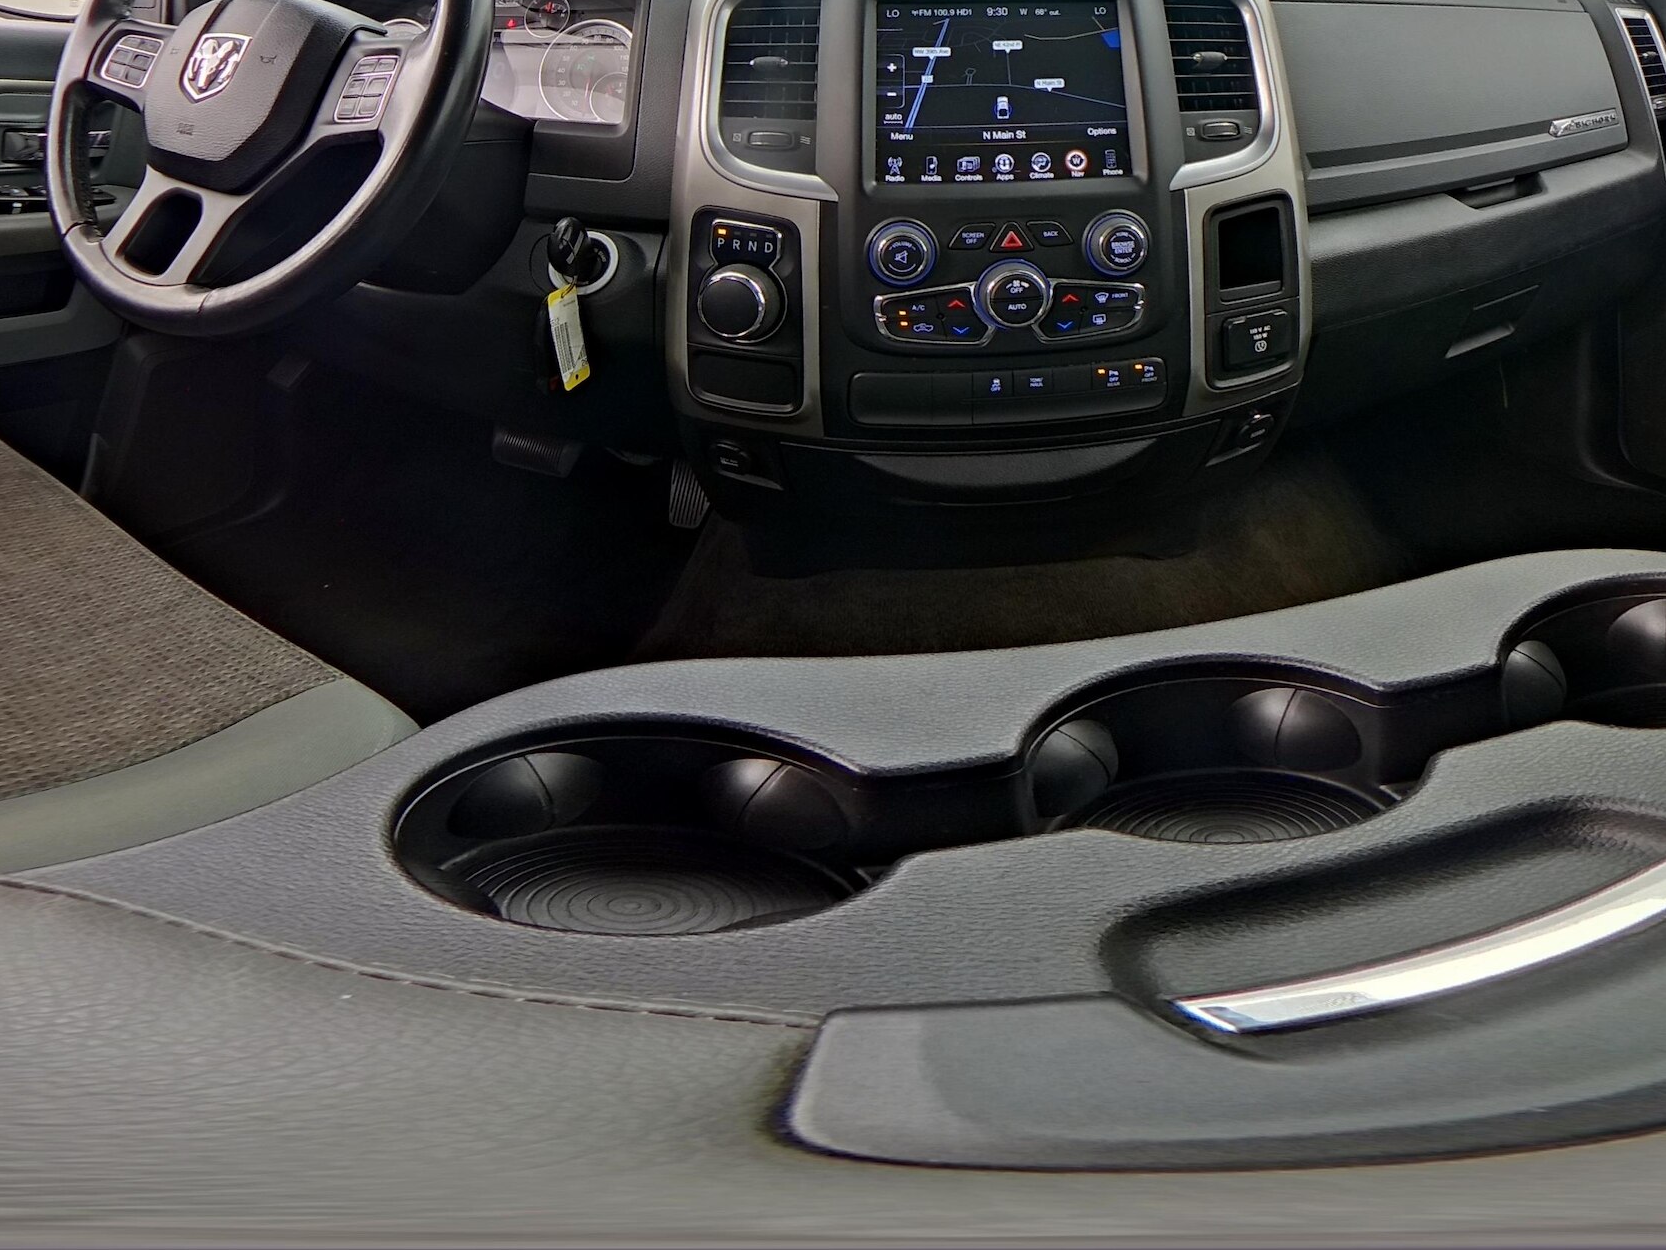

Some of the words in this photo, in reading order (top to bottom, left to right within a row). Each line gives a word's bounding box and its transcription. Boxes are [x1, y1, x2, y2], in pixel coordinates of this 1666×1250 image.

[886, 9, 900, 18] LO
[956, 8, 973, 16] HD1
[986, 7, 1008, 16] 9:30
[1094, 6, 1107, 15] LO
[890, 132, 914, 141] Menu
[982, 131, 991, 140] N
[992, 130, 1014, 140] Main
[1015, 130, 1026, 139] St
[1087, 127, 1117, 137] Options
[885, 174, 905, 182] Radio
[921, 174, 942, 182] Media
[954, 174, 983, 182] Controls
[996, 173, 1014, 181] Apps
[1102, 168, 1124, 176] Phone
[717, 237, 725, 248] P
[732, 239, 741, 251] R
[747, 240, 757, 252] N
[764, 241, 774, 253] D
[892, 240, 913, 248] VOLUME
